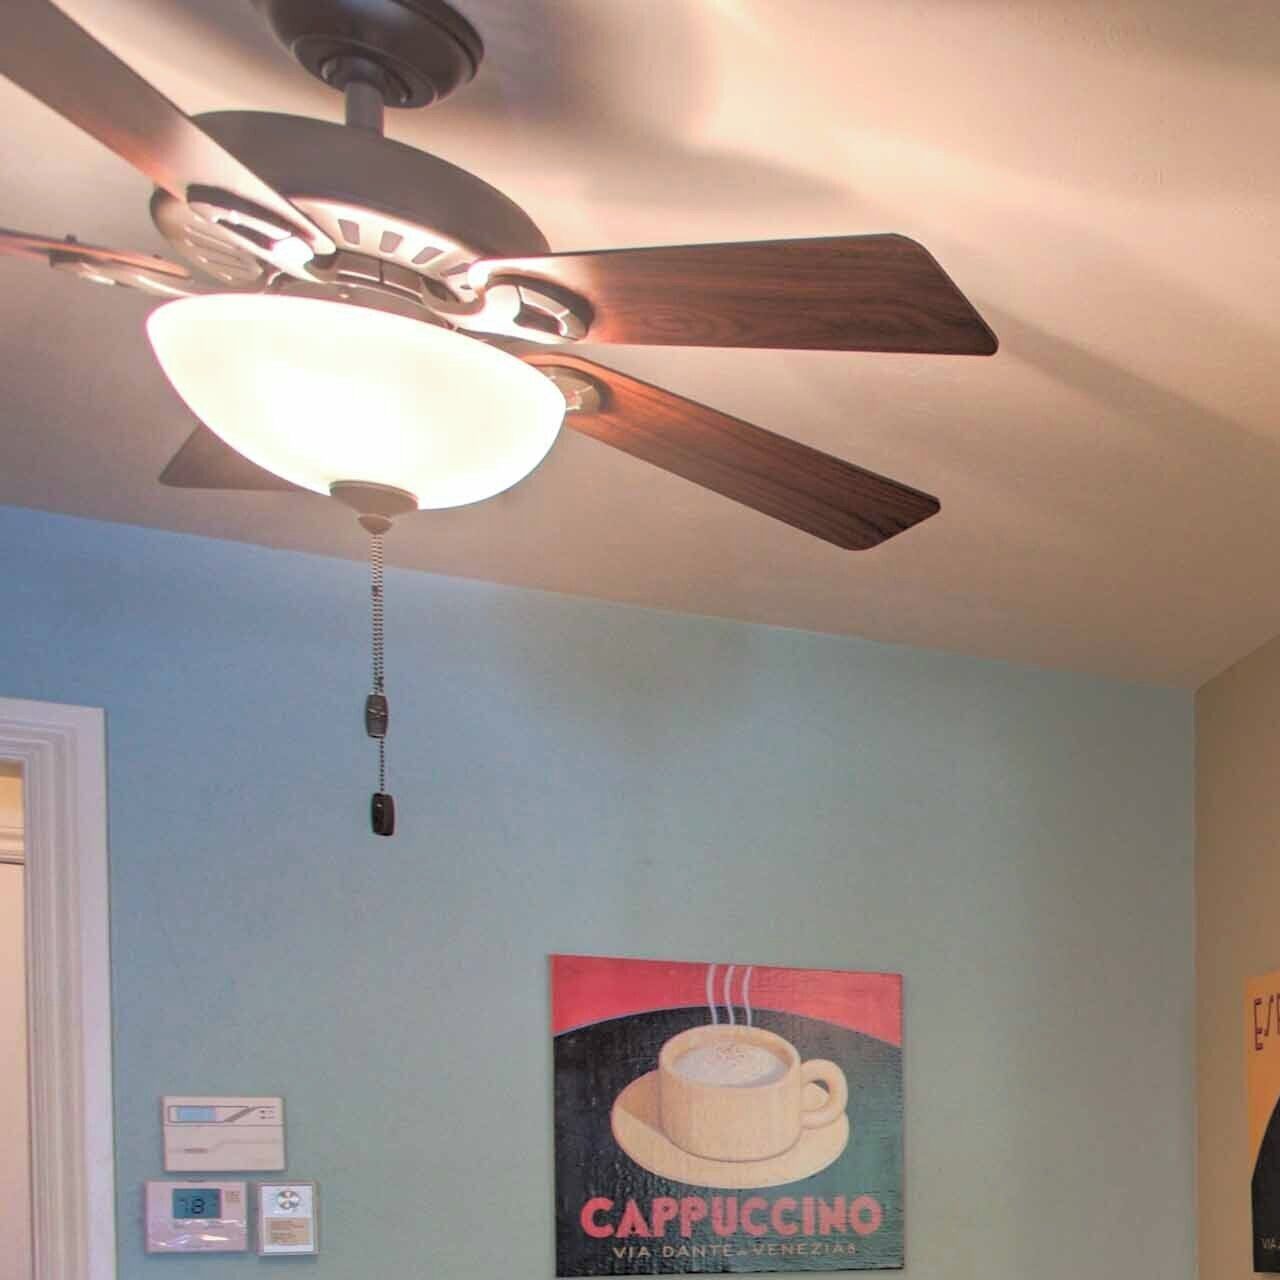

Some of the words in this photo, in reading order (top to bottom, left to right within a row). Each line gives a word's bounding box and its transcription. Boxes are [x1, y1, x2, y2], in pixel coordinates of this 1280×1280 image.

[580, 1195, 882, 1239] CAPPUCCINO
[613, 1245, 651, 1259] VIA
[662, 1243, 735, 1259] DANTE
